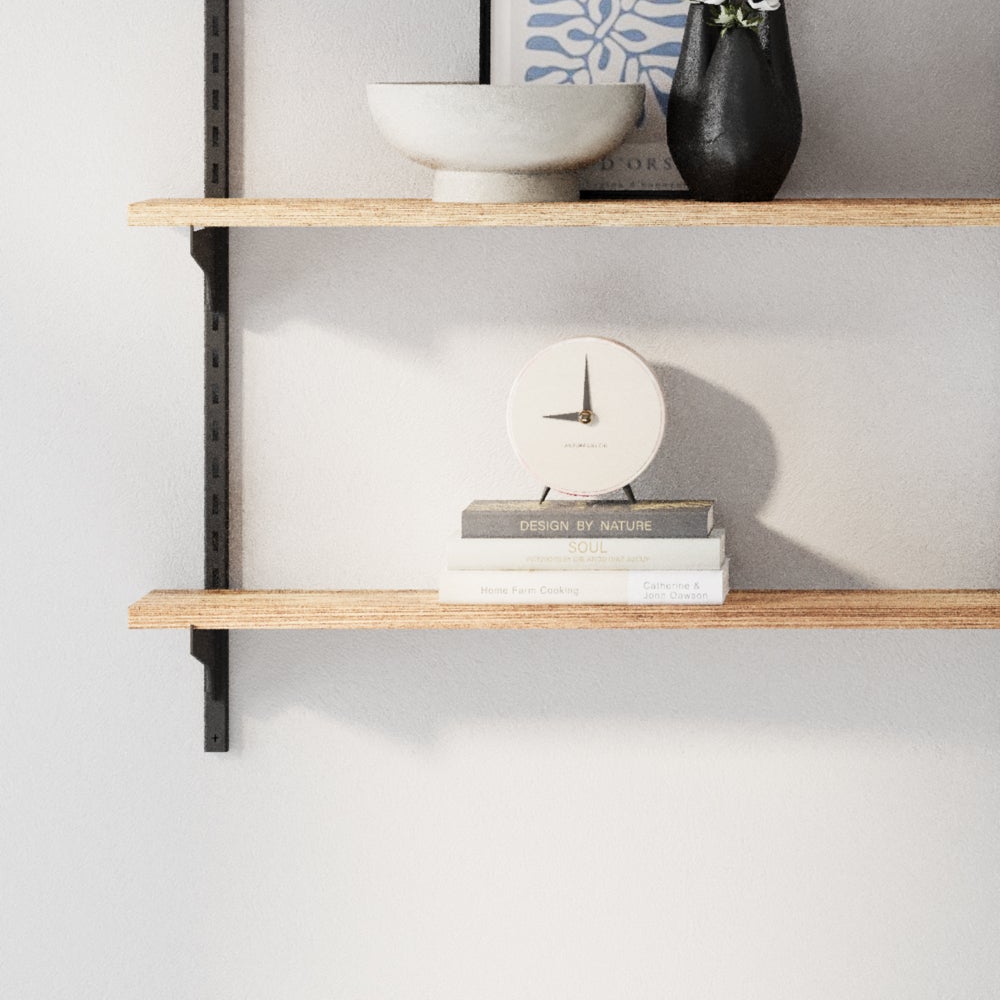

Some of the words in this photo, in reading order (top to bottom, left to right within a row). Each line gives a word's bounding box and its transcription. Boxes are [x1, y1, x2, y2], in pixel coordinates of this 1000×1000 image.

[520, 520, 568, 531] DESIGN
[577, 520, 593, 531] BY
[600, 520, 652, 531] NATURE
[568, 541, 607, 553] SOUL
[643, 581, 690, 590] Catherine
[693, 582, 700, 590] &
[480, 586, 508, 595] Home
[512, 586, 536, 595] Farm
[540, 586, 579, 597] Cooking
[643, 591, 666, 600] John
[670, 591, 709, 600] Dawson
